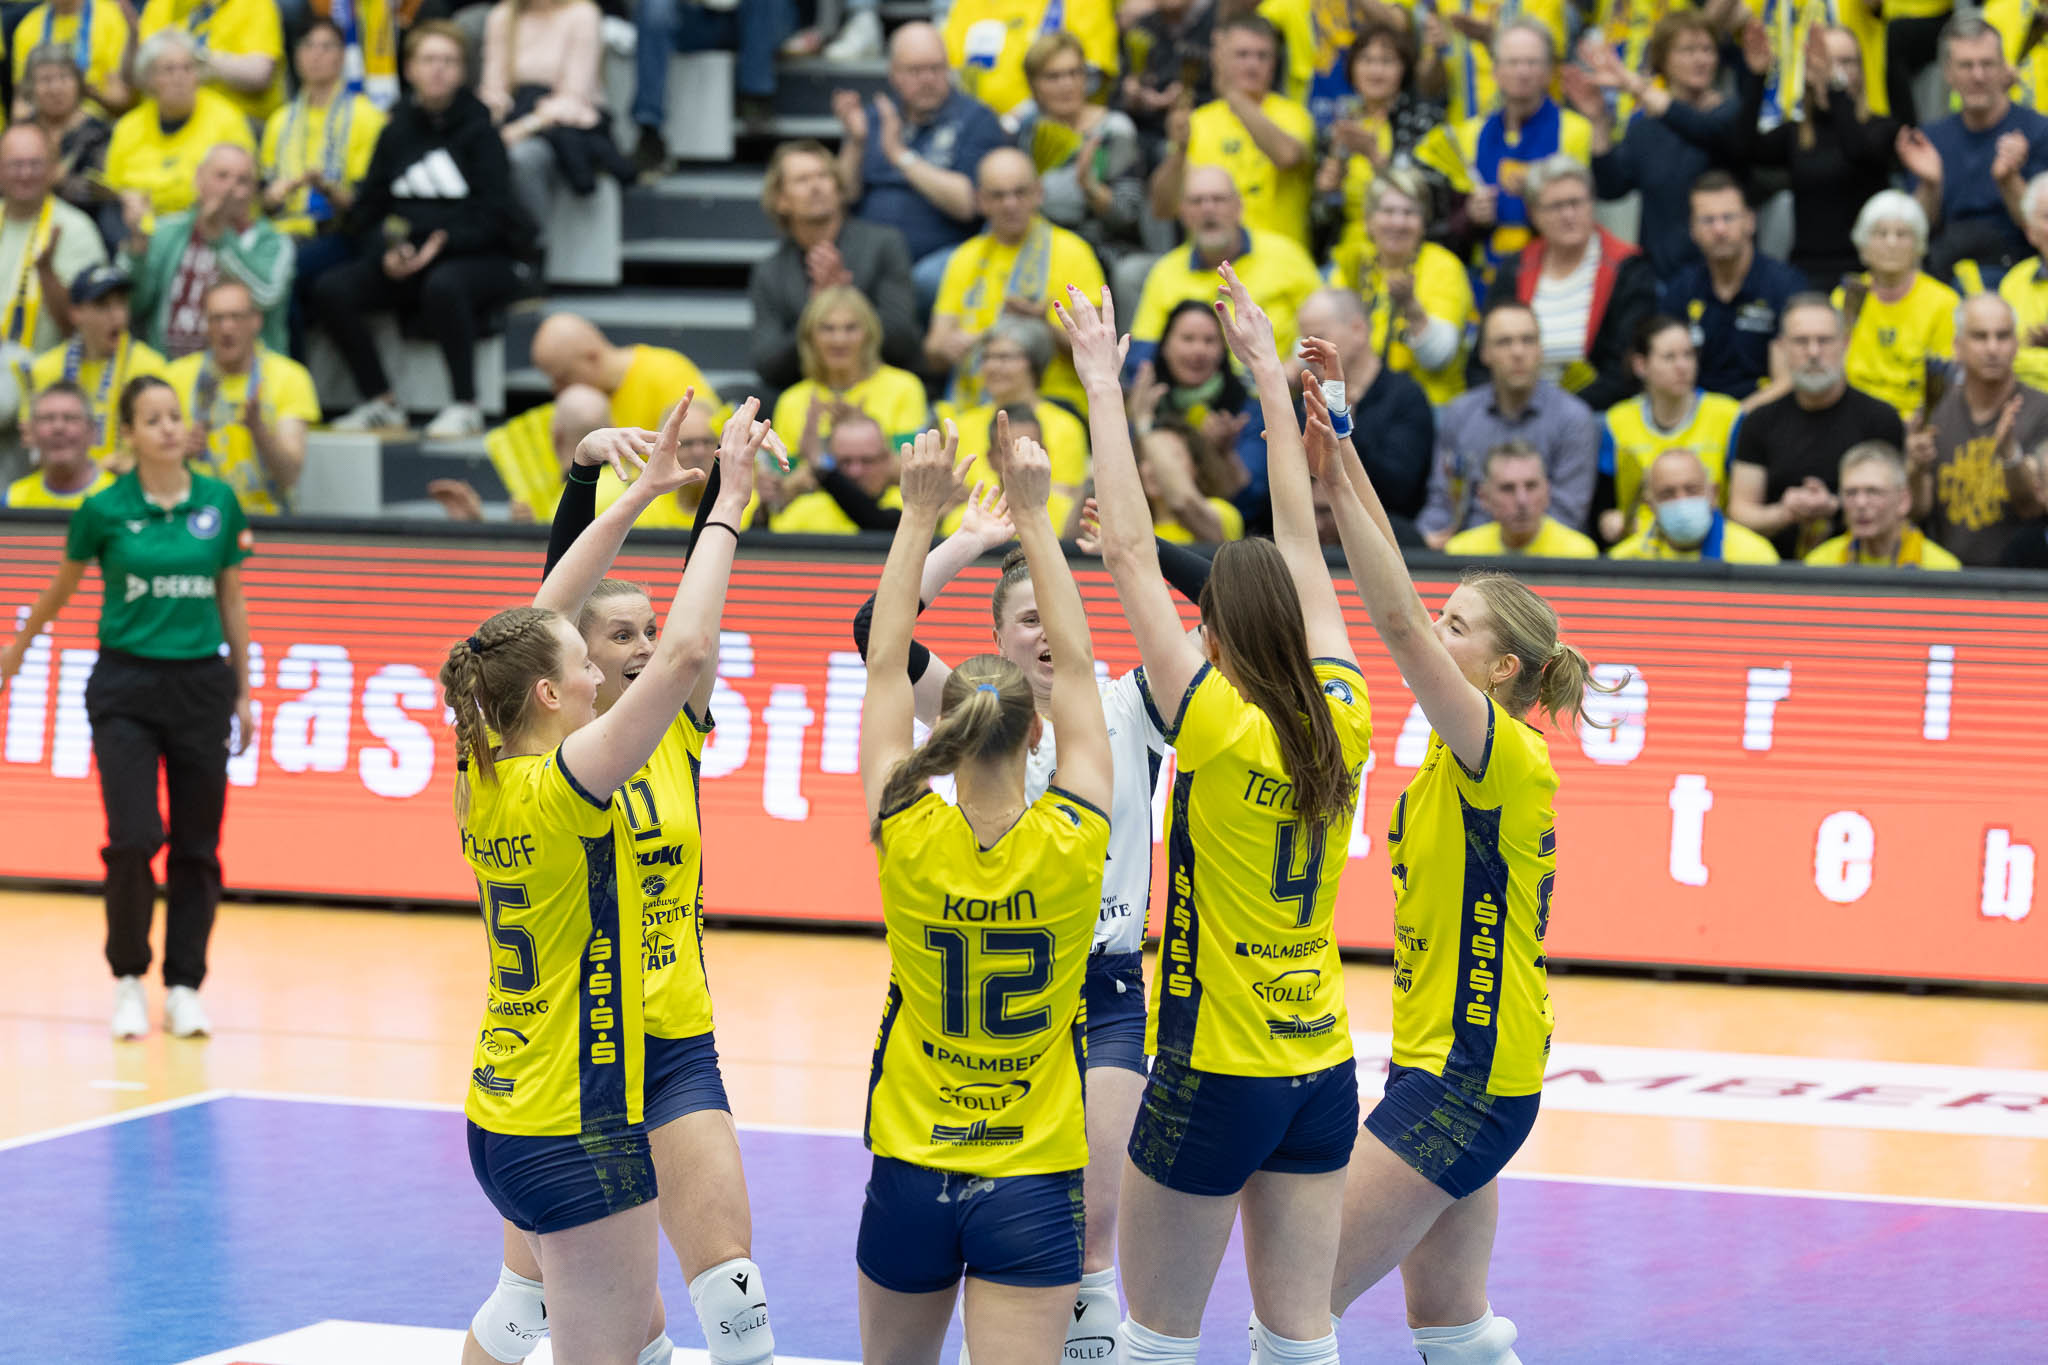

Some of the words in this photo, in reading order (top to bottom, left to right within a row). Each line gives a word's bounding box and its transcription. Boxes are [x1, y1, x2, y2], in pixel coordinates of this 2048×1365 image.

[1270, 815, 1328, 929] 4
[1814, 810, 1875, 903] e
[943, 890, 1038, 922] KOHN
[1100, 904, 1132, 921] UTE
[924, 926, 1056, 1039] 12
[1063, 1346, 1104, 1360] TOLLE
